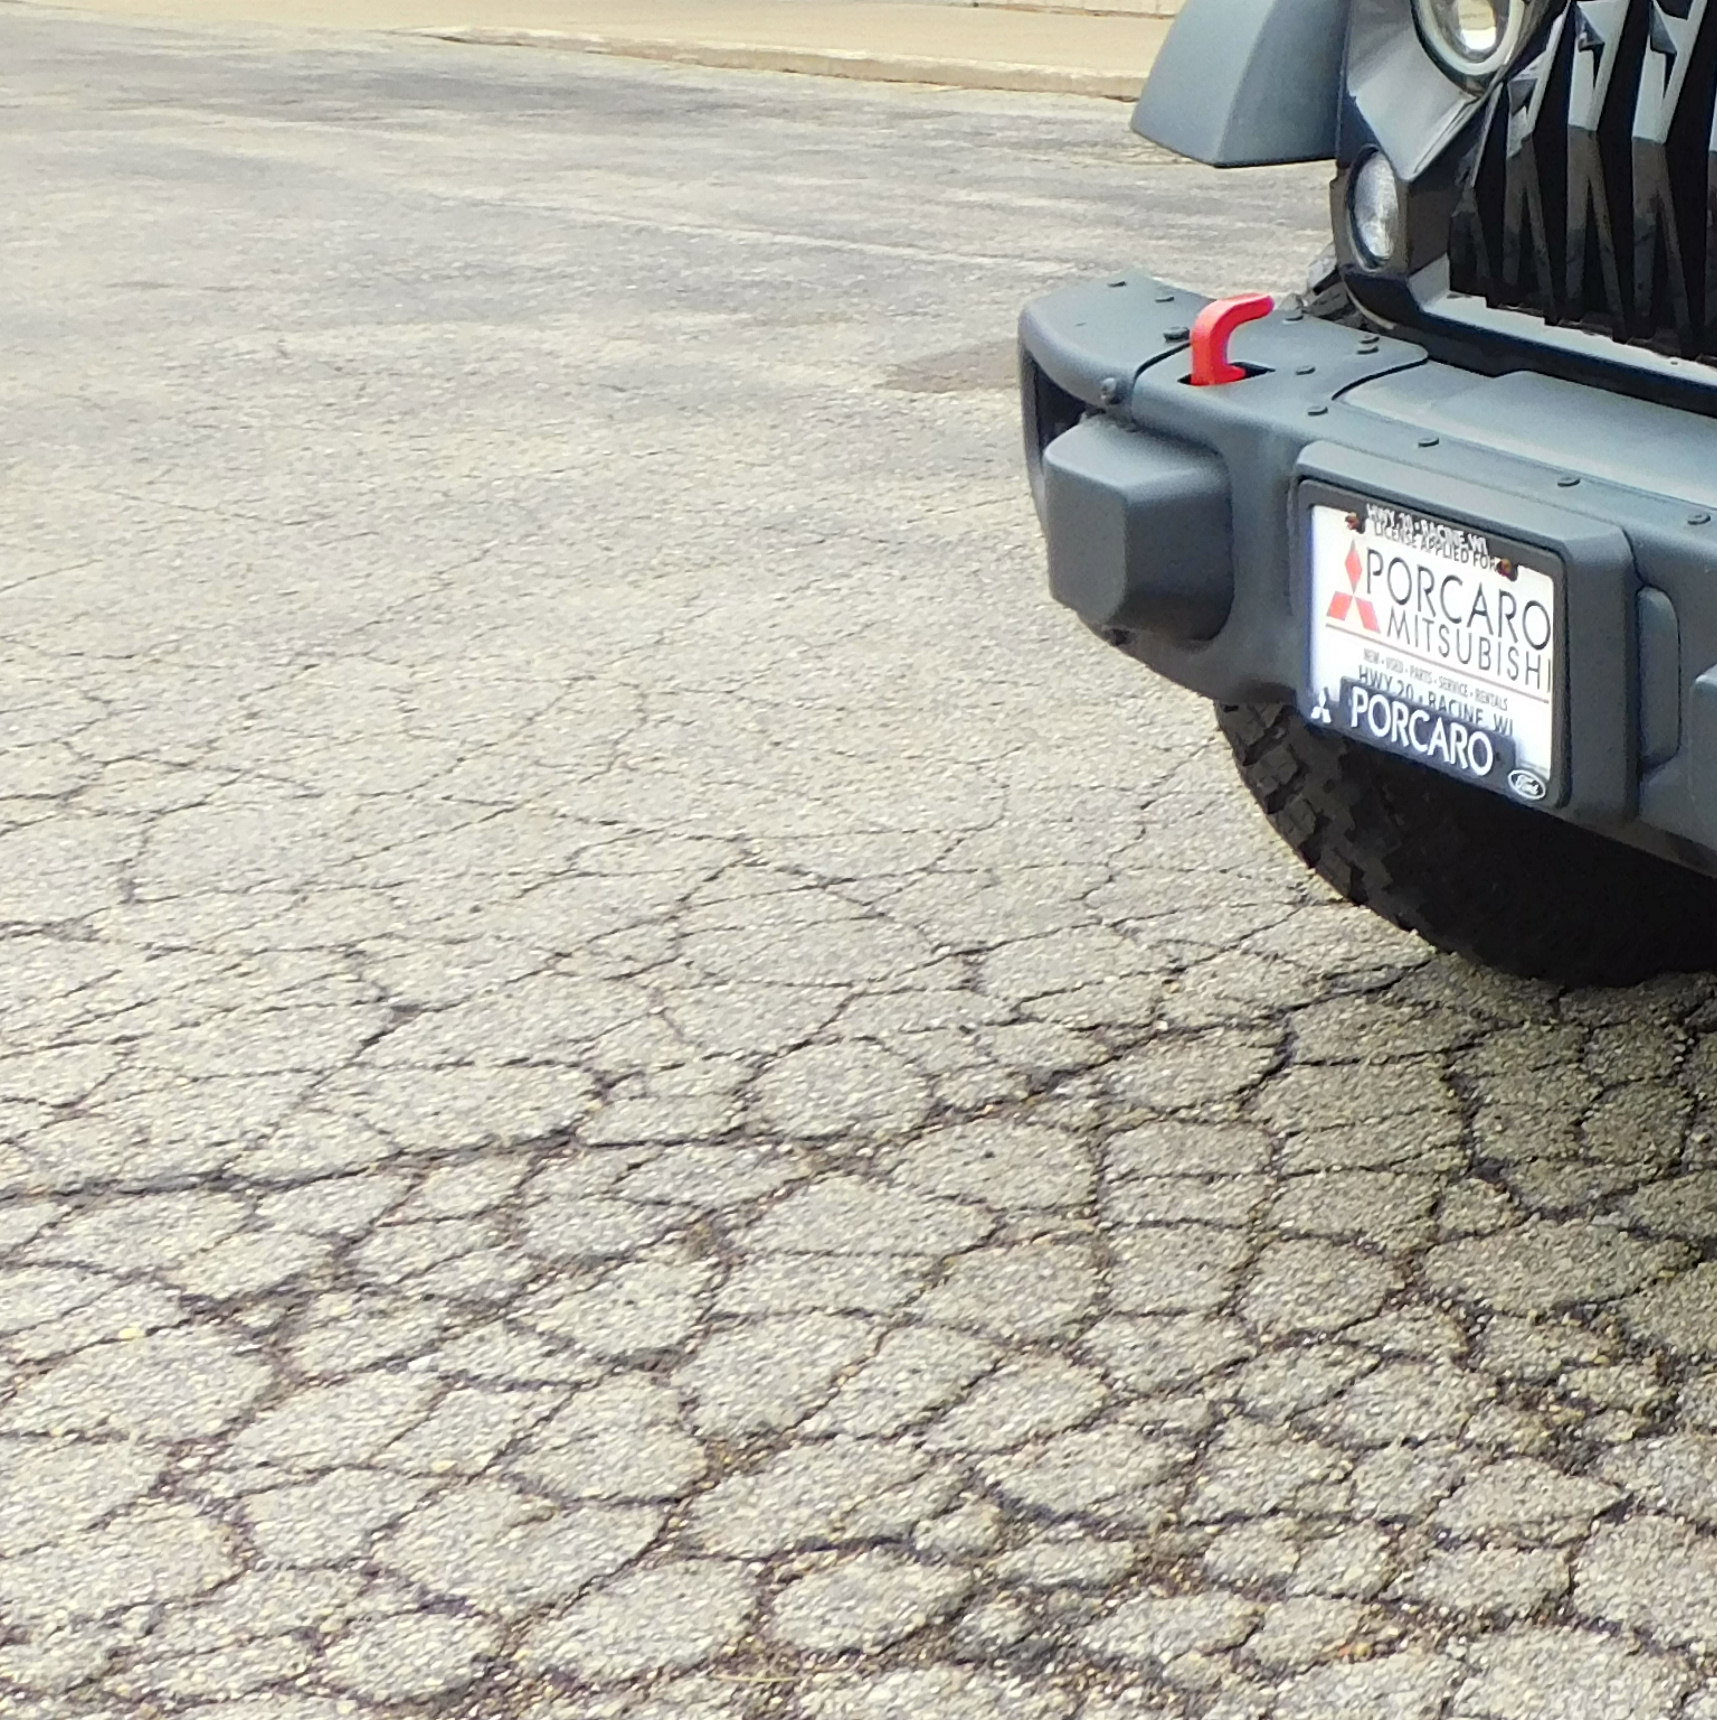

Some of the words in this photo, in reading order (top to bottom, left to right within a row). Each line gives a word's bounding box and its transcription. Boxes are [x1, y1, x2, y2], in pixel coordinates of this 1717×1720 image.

[1366, 503, 1396, 526] HWY
[1374, 521, 1417, 549] LICENSE
[1420, 533, 1469, 564] APPLIED
[1367, 547, 1551, 650] PORCARO
[1385, 656, 1404, 674] USED
[1409, 664, 1433, 685] PARTS
[1438, 675, 1469, 697] SERVICE
[1474, 687, 1509, 712] RENTALS
[1387, 605, 1551, 693] MITSUBISHI
[1351, 686, 1493, 776] PORCARO
[1358, 664, 1393, 692] HWY
[1396, 680, 1414, 701] 20
[1428, 690, 1484, 726] RACINE
[1493, 713, 1514, 737] WI
